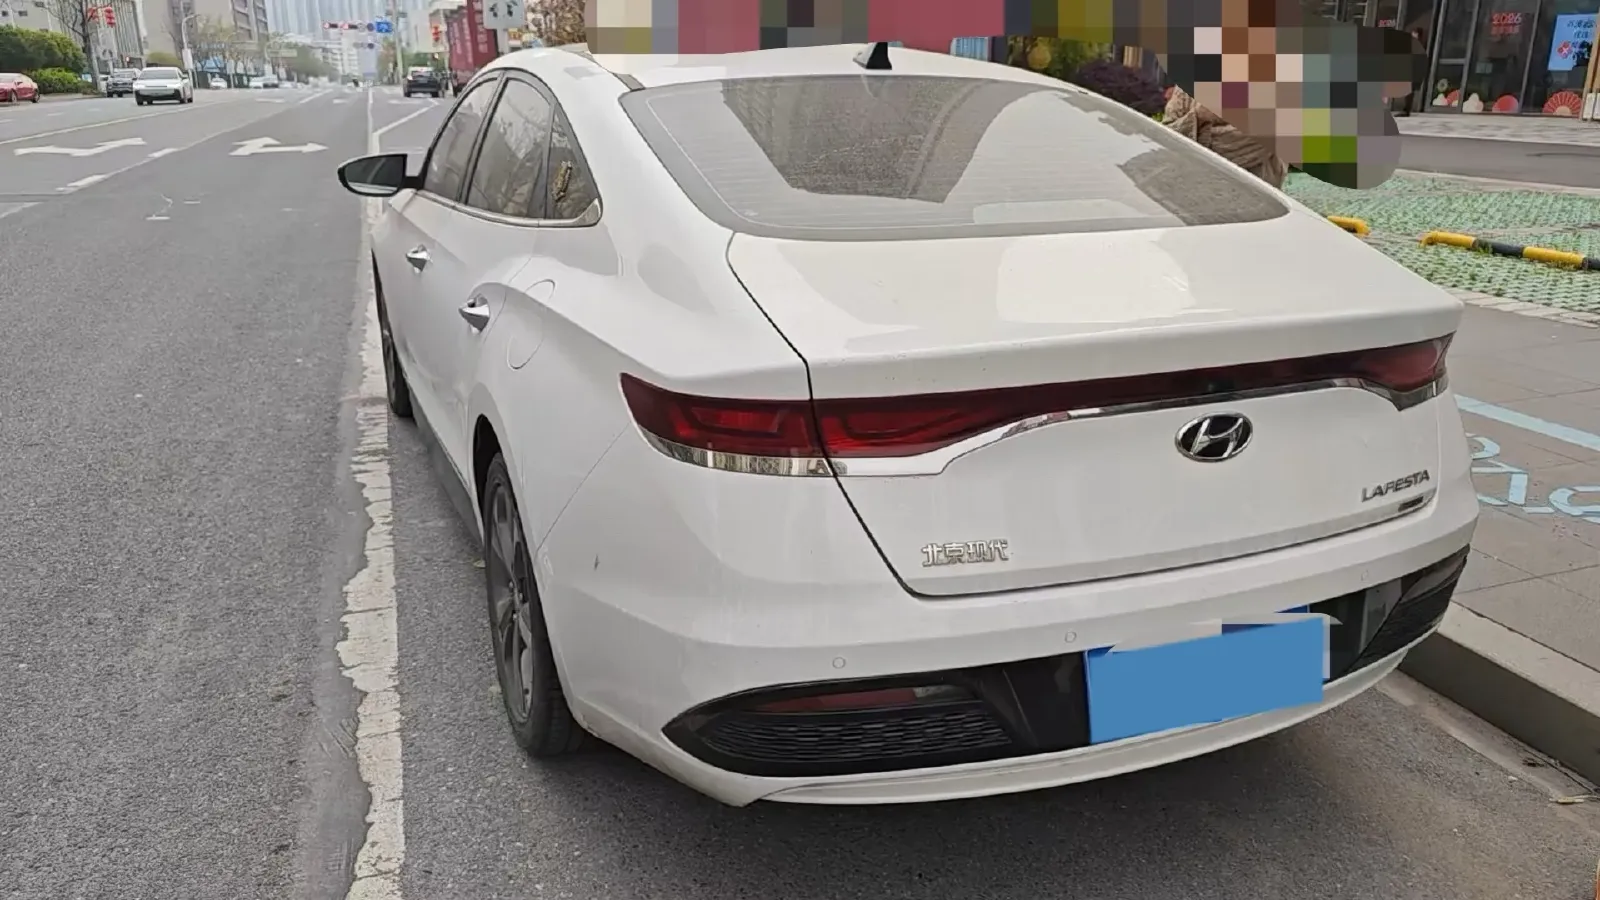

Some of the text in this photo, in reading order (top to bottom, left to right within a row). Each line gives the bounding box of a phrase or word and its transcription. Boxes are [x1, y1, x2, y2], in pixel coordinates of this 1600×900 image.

[1361, 469, 1430, 502] LAFESTA
[921, 539, 1009, 567] 北京现代
